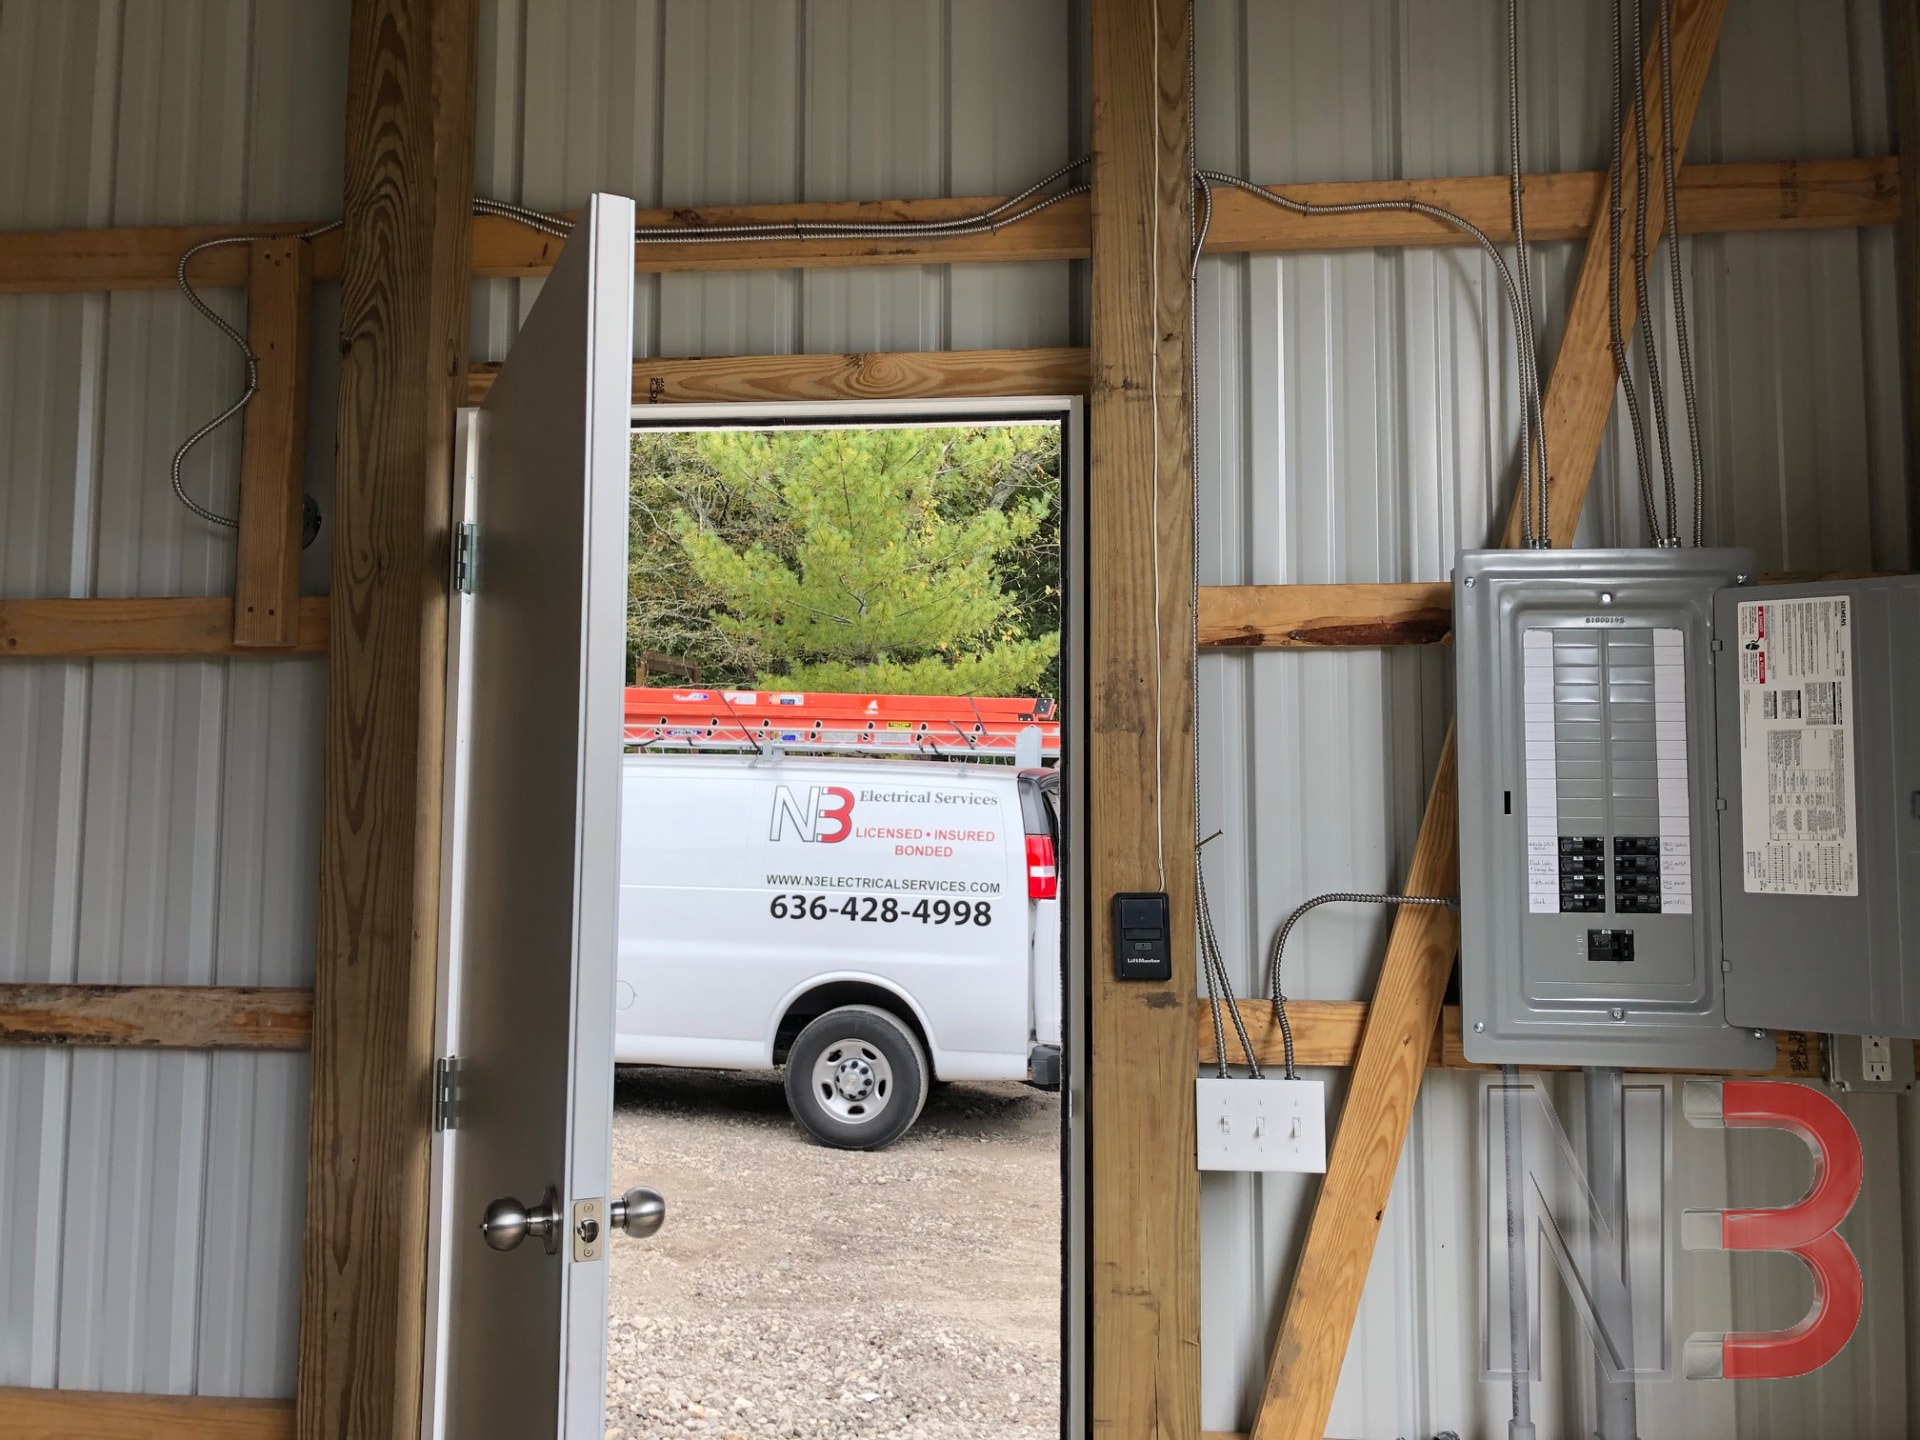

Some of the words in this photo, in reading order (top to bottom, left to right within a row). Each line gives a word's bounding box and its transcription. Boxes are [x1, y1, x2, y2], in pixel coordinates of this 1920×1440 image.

[859, 790, 931, 804] Electrical
[933, 792, 999, 807] Services
[855, 827, 923, 840] LICENSED
[934, 829, 996, 842] INSURED
[894, 845, 954, 857] BONDED
[766, 874, 1000, 894] WWW.N3ELECTRICALSERVICES.COM
[769, 894, 992, 927] 636-428-4998
